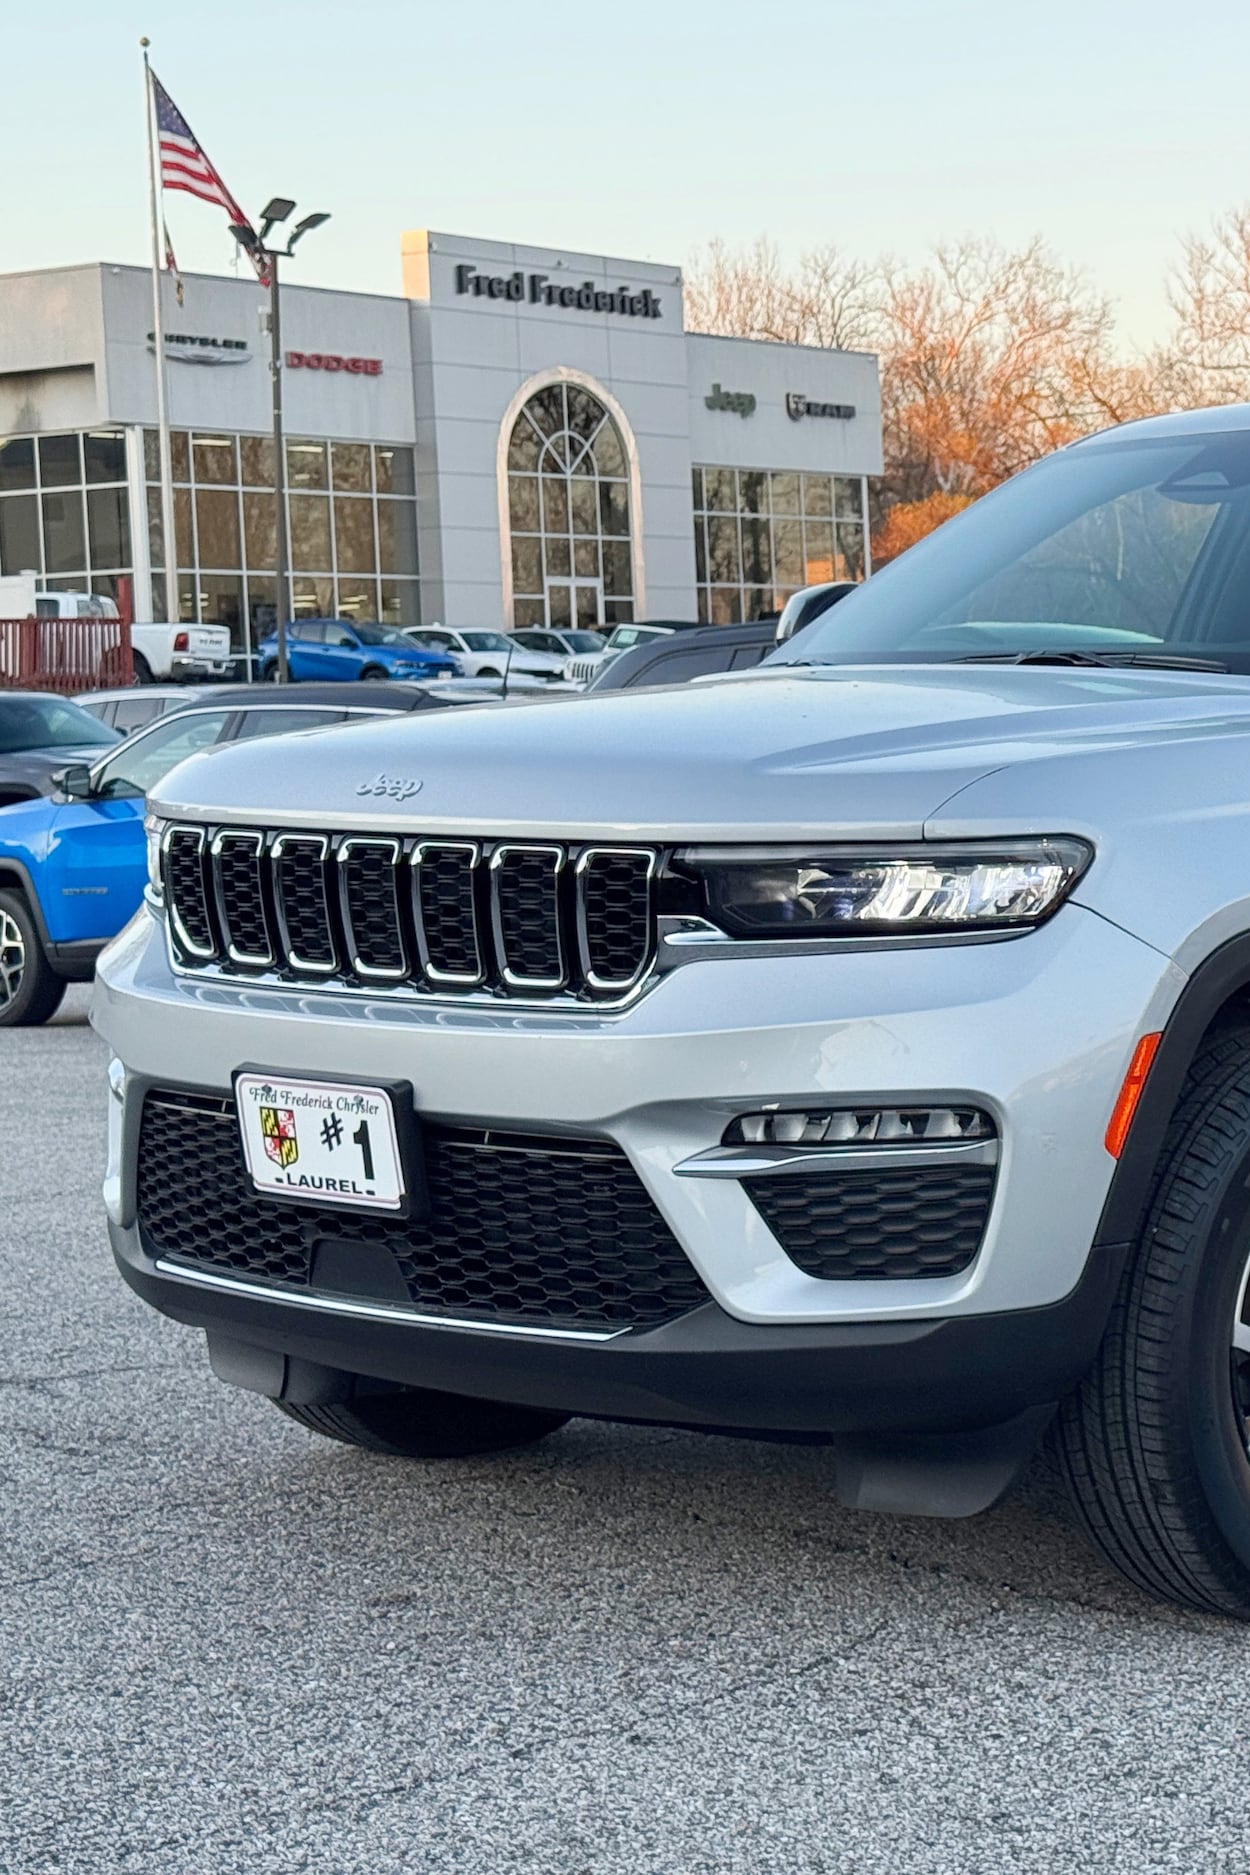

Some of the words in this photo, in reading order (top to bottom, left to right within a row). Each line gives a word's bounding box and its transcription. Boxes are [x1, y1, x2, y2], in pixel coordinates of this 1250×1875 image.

[456, 264, 524, 300] Fred
[529, 274, 662, 318] Frederick
[286, 351, 383, 376] DODGE
[704, 383, 757, 420] Jeep
[356, 773, 424, 802] Jeep
[249, 1087, 277, 1104] Fred
[280, 1092, 333, 1110] Frederick
[336, 1097, 379, 1115] Chrysler
